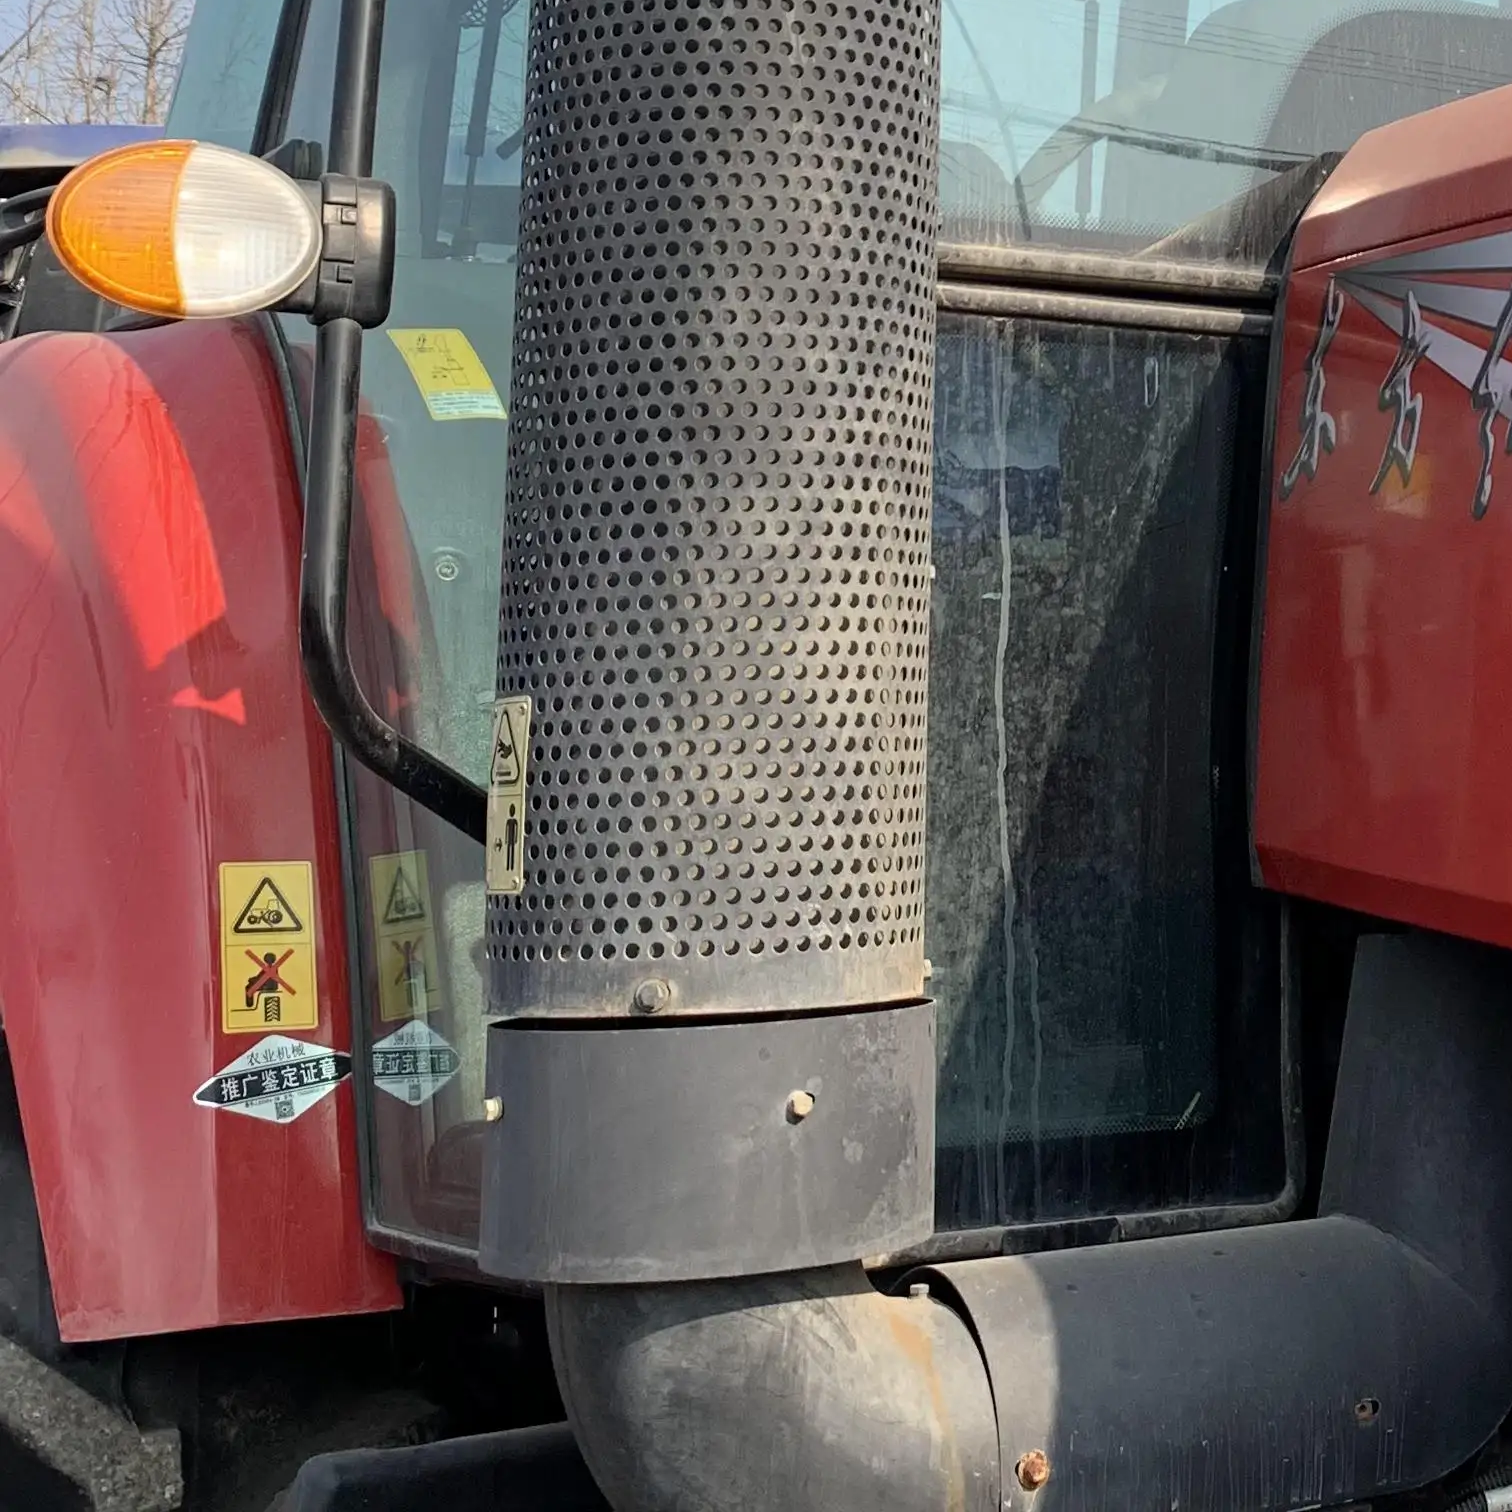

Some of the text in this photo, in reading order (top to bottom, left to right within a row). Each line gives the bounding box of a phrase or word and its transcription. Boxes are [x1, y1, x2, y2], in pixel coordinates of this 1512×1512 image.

[247, 1044, 306, 1067] 农业机械
[220, 1056, 339, 1102] 推广鉴定证章
